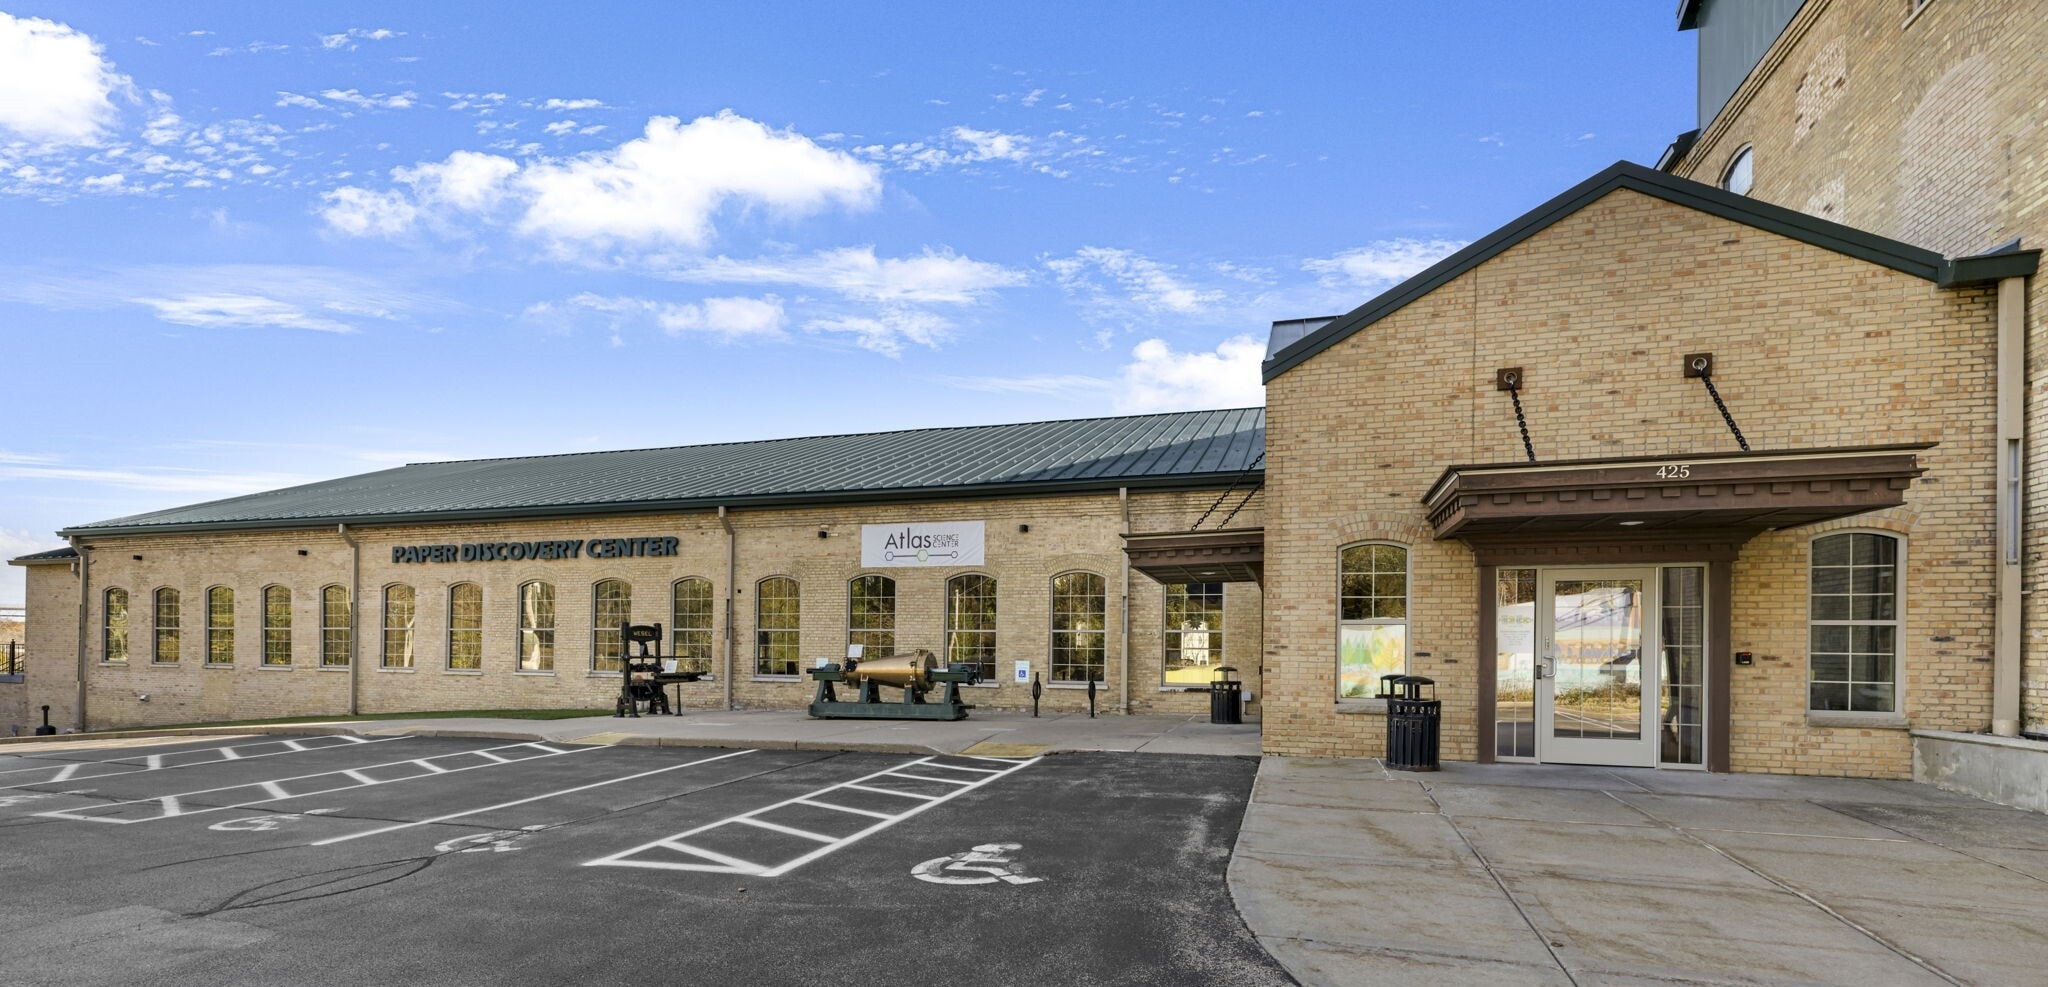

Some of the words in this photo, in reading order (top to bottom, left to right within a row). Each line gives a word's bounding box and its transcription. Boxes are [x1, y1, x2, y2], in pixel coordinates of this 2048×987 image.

[1656, 464, 1690, 479] 425
[884, 527, 932, 550] Atlas
[932, 533, 960, 541] SCIENCE
[932, 540, 959, 549] CENTER
[391, 545, 457, 563] PAPER
[460, 540, 583, 562] DISCOVERY
[585, 536, 680, 558] CENTER
